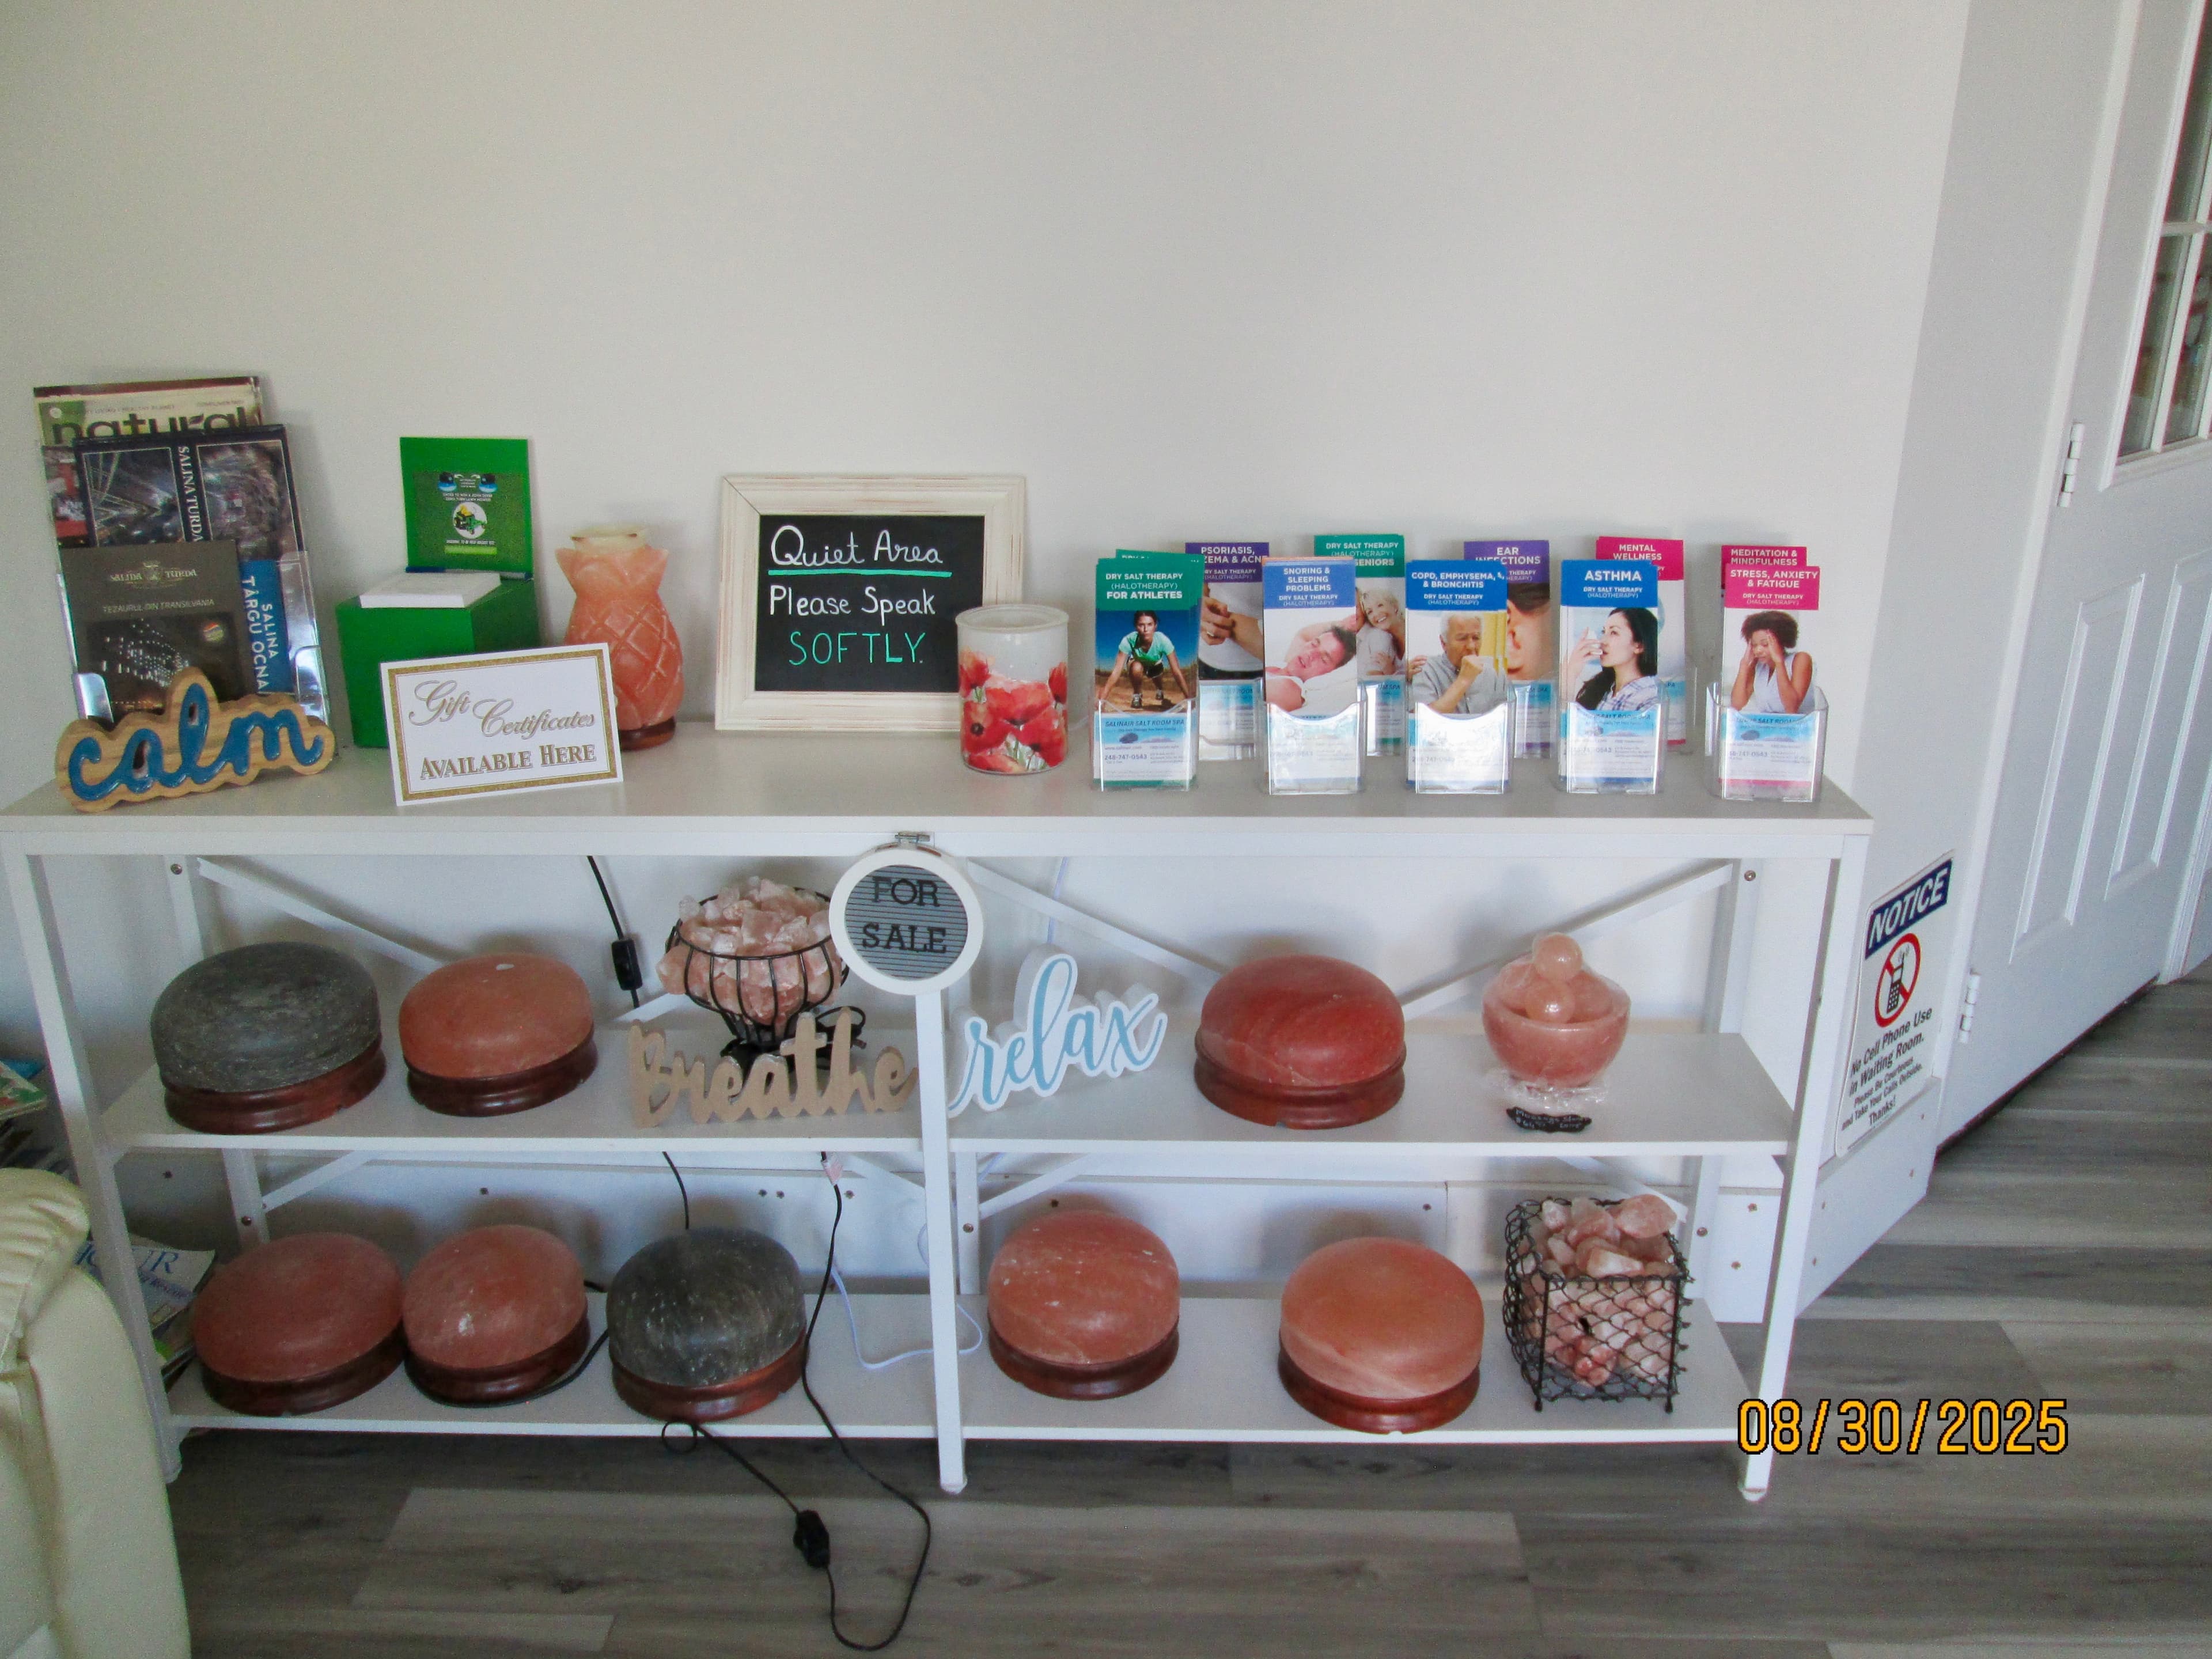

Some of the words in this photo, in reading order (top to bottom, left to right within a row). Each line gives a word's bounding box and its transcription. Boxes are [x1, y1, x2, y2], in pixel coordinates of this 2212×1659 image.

[52, 407, 247, 444] natural
[179, 446, 196, 494] SALINA
[187, 496, 203, 542] TURDA
[771, 525, 865, 567] Quiet
[874, 529, 943, 563] Area
[1201, 547, 1255, 555] PSORIASIS,
[1497, 547, 1519, 555] EAR
[1613, 552, 1662, 560] WELLNESS
[1731, 549, 1788, 557] MEDITATION
[1731, 558, 1797, 566] MINDFULNESS
[1440, 573, 1496, 581] EMPHYSEMA,
[1585, 570, 1642, 581] ASTHMA
[1730, 570, 1770, 579] STRESS,
[1773, 570, 1819, 579] ANXIETY
[1757, 579, 1800, 588] FATIGUE
[242, 575, 263, 634] TÂRGU
[770, 585, 851, 616] Please
[862, 586, 935, 626] Speak
[1107, 591, 1128, 599] FOR
[1130, 590, 1183, 599] ATHLETES
[262, 604, 279, 658] SALINA
[789, 631, 926, 666] SOFTLY.
[252, 641, 269, 690] OCNA
[408, 680, 471, 726] Gift
[472, 698, 596, 740] Certificates
[68, 683, 324, 801] calm
[420, 750, 533, 780] AVAILABLE
[539, 744, 597, 767] HERE
[873, 877, 940, 907] FOR
[1869, 868, 1948, 949] NOTICE
[862, 923, 946, 953] SALE
[948, 957, 1162, 1112] relax
[1851, 1059, 1861, 1077] No
[1863, 1040, 1880, 1065] Cell
[1883, 1021, 1911, 1049] Phone
[1914, 1008, 1932, 1027] Use
[630, 1006, 918, 1129] Breathe
[1850, 1082, 1858, 1097] in
[1861, 1050, 1894, 1086] Waiting
[1896, 1032, 1924, 1059] Room.
[1855, 1104, 1868, 1120] Take
[1884, 1081, 1898, 1097] Calls
[1869, 1095, 1896, 1125] Thanks!
